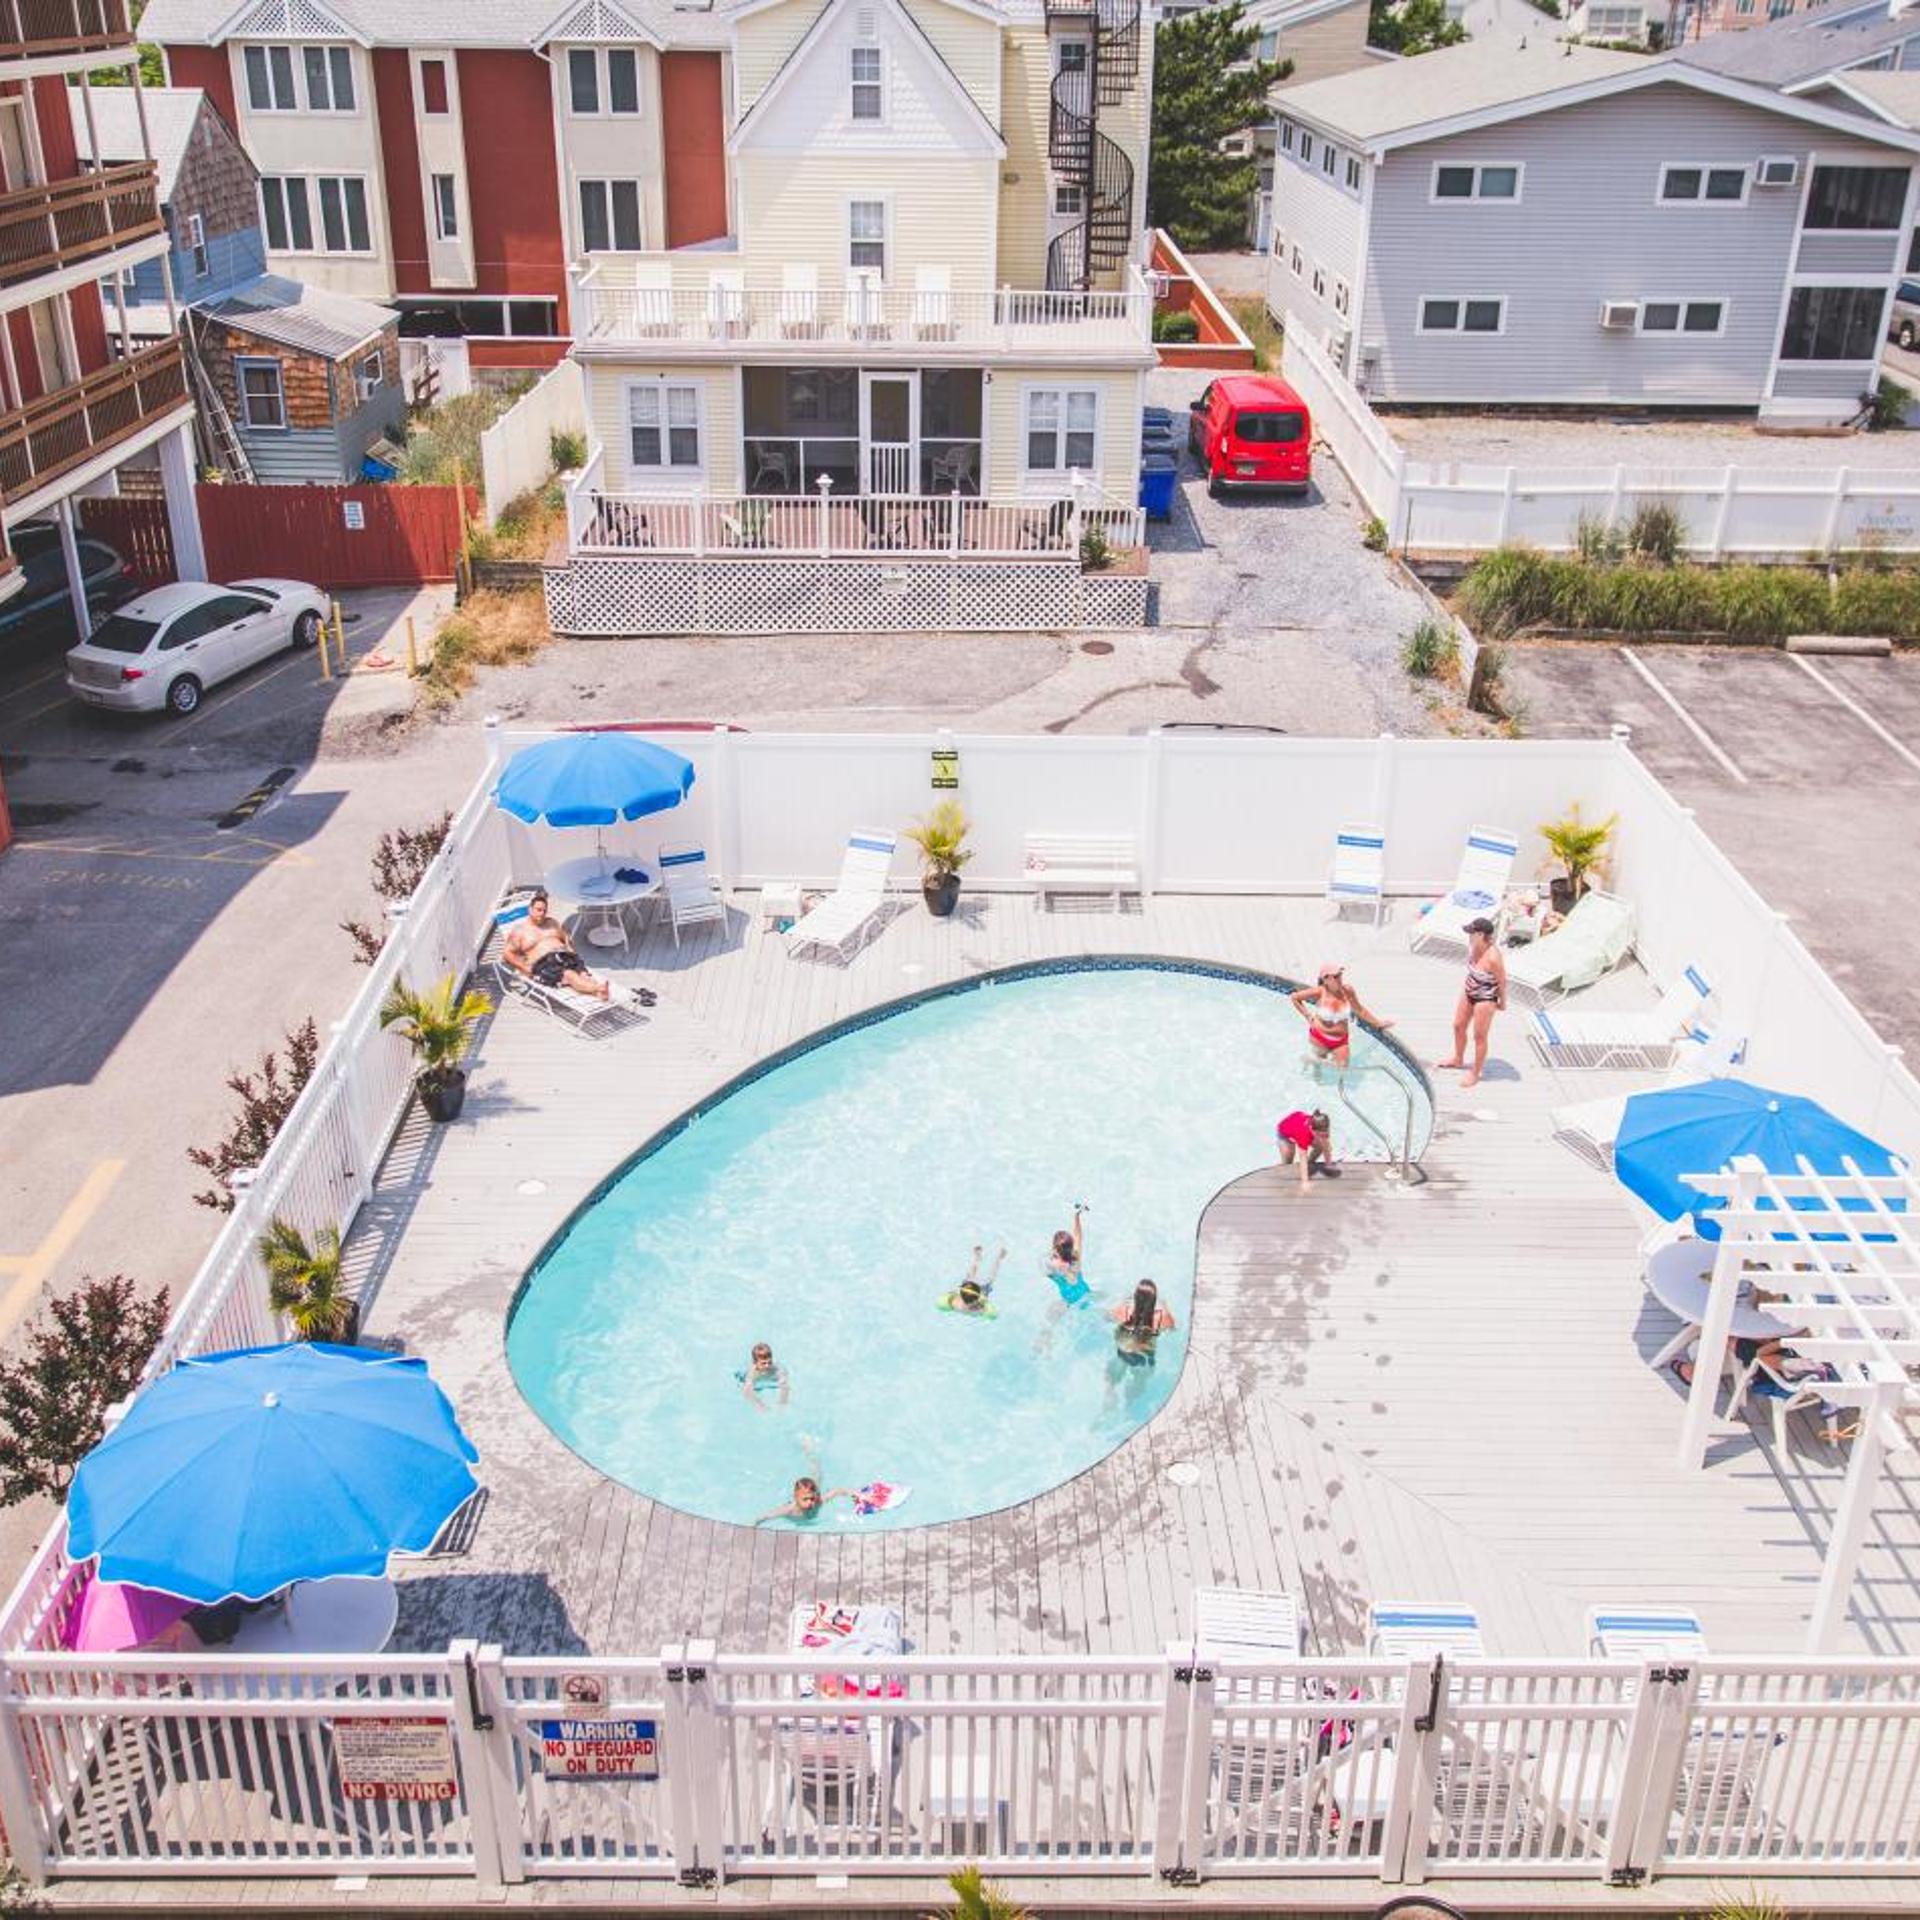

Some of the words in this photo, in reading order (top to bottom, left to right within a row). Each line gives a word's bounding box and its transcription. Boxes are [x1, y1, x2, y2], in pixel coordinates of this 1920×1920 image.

[559, 1721, 637, 1739] WARNING
[546, 1741, 566, 1756] NO
[573, 1741, 654, 1756] LIFEGUARD
[567, 1759, 588, 1773] ON
[596, 1759, 635, 1773] DUTY
[348, 1783, 376, 1798] NO
[384, 1783, 451, 1799] DIVING
